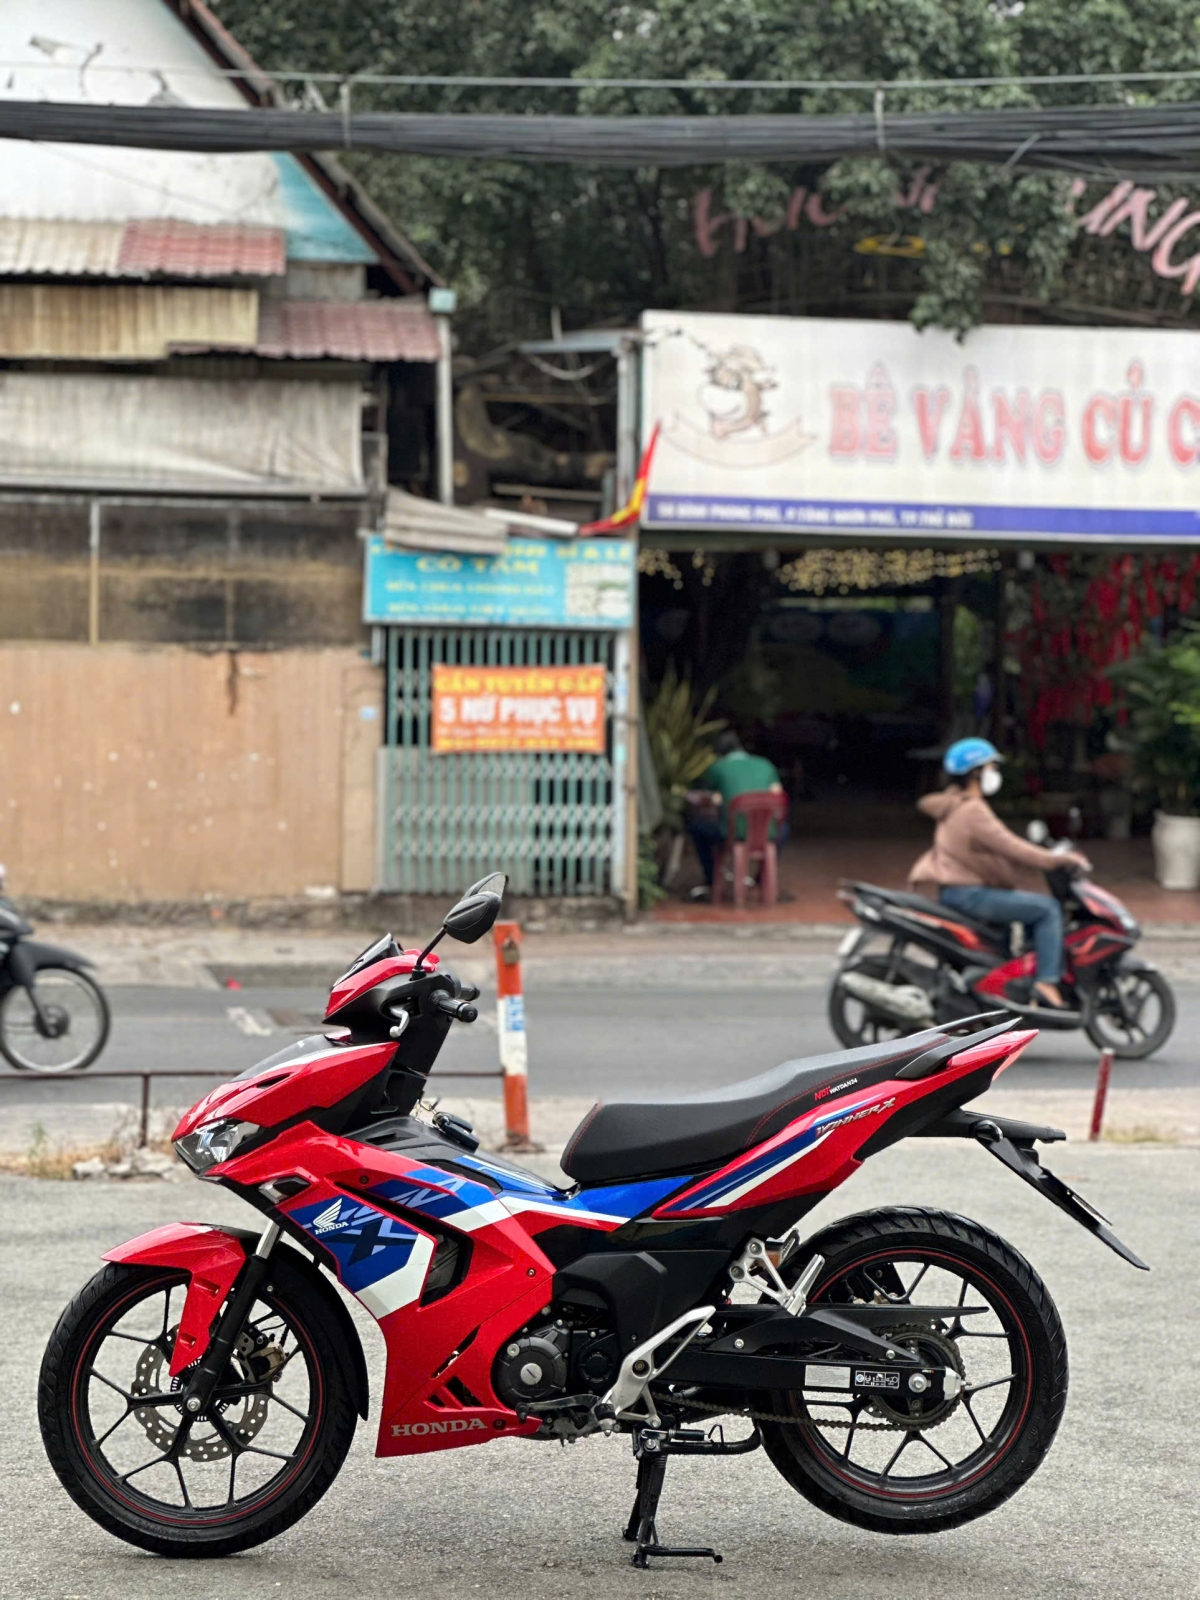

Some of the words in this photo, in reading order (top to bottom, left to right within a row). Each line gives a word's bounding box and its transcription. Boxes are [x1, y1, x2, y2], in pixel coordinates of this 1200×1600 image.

[1081, 359, 1153, 466] CỦ
[314, 1221, 349, 1236] HONDA
[390, 1418, 488, 1438] HONDA
